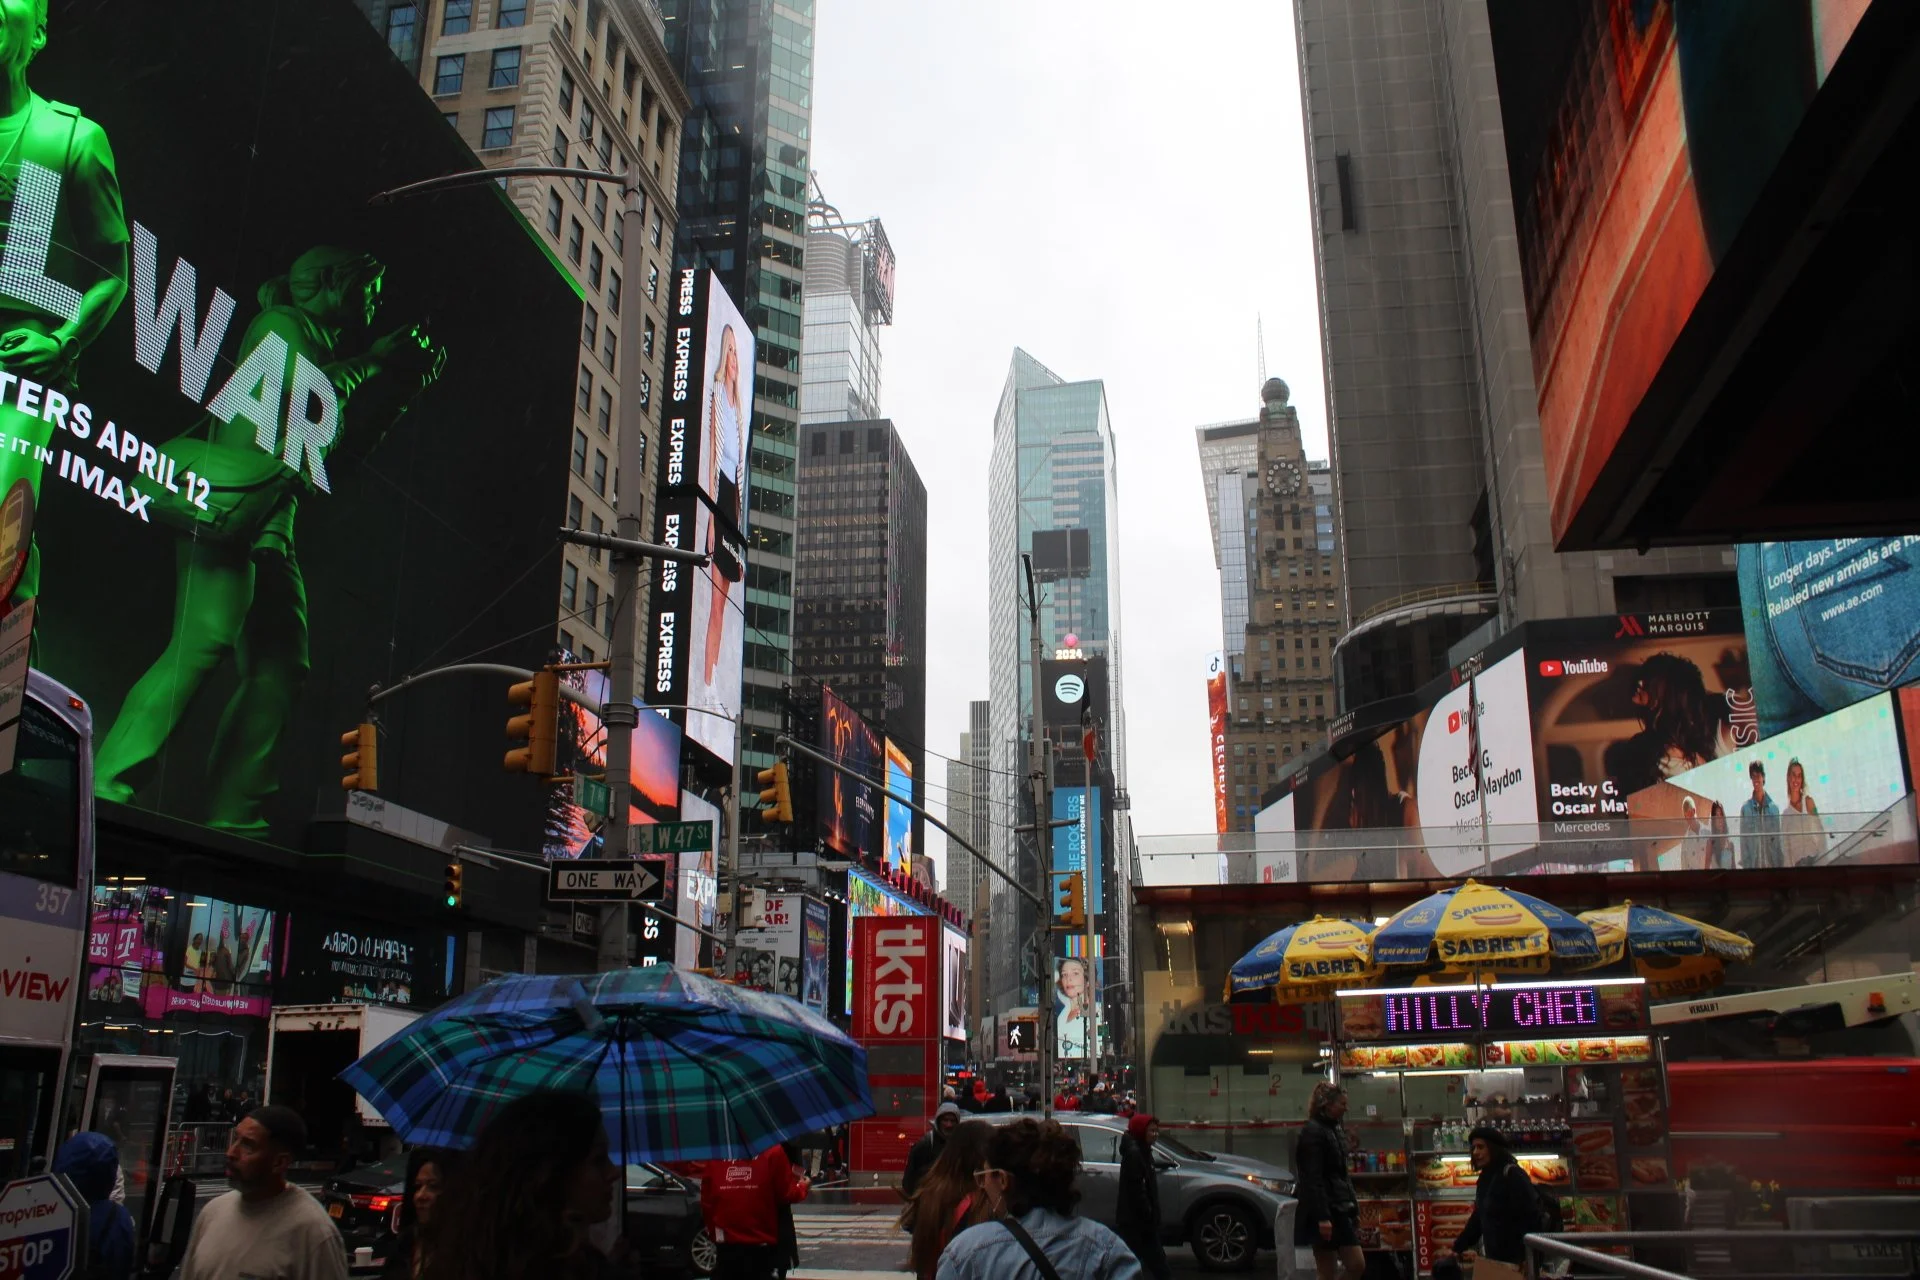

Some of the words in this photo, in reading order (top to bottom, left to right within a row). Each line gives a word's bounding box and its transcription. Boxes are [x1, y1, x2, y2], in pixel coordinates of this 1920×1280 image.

[679, 268, 694, 316] PRESS
[133, 220, 340, 495] WAR
[672, 327, 691, 402] EXPRESS
[96, 420, 179, 494] APRIL
[185, 471, 210, 511] 12
[667, 418, 685, 486] EXPRES
[11, 436, 31, 456] IT
[34, 445, 53, 465] IN
[59, 449, 151, 523] IMAX
[662, 513, 680, 593] EXPESS
[1768, 563, 1803, 590] Longer
[1805, 547, 1834, 569] days.
[1768, 583, 1809, 618] Relaxed
[1811, 574, 1834, 596] new
[1837, 549, 1879, 582] arrivals
[1881, 539, 1901, 559] are
[1648, 611, 1710, 623] MARRIOTT
[1821, 584, 1883, 622] www.ae.com
[1650, 622, 1704, 633] MARQUIS
[657, 612, 675, 693] EXPRESS
[1056, 649, 1083, 660] 2024
[1562, 658, 1608, 675] YouTube
[1726, 688, 1760, 748] SIC
[1452, 764, 1476, 783] Beck
[1482, 749, 1493, 769] G,
[1080, 794, 1085, 805] ME
[1454, 788, 1479, 809] Oscar
[1483, 768, 1522, 795] Maydon
[1550, 782, 1598, 798] Becky
[1601, 780, 1619, 796] G,
[1068, 795, 1080, 851] ROGERS
[1552, 801, 1597, 815] Oscar
[658, 827, 671, 849] W
[674, 827, 694, 849] 47
[697, 823, 708, 839] St
[1554, 822, 1611, 833] Mercedes
[566, 873, 598, 888] ONE
[614, 873, 648, 888] WAY
[36, 883, 73, 917] 357
[1451, 903, 1514, 920] SABRETT
[576, 913, 592, 935] ONE
[1442, 934, 1544, 956] SABRETT
[0, 967, 69, 1003] VIEW
[873, 923, 926, 1035] tkts
[1160, 999, 1232, 1035] tkts
[1389, 993, 1492, 1031] HILLY
[1513, 990, 1596, 1026] CHEE
[1689, 1002, 1719, 1014] VERSALIFT
[1213, 1074, 1220, 1089] 1
[1271, 1074, 1282, 1089] 2
[1417, 1203, 1426, 1232] HOT
[0, 1238, 54, 1272] STOP
[1419, 1236, 1430, 1266] DOG
[1853, 1244, 1901, 1258] TIME
